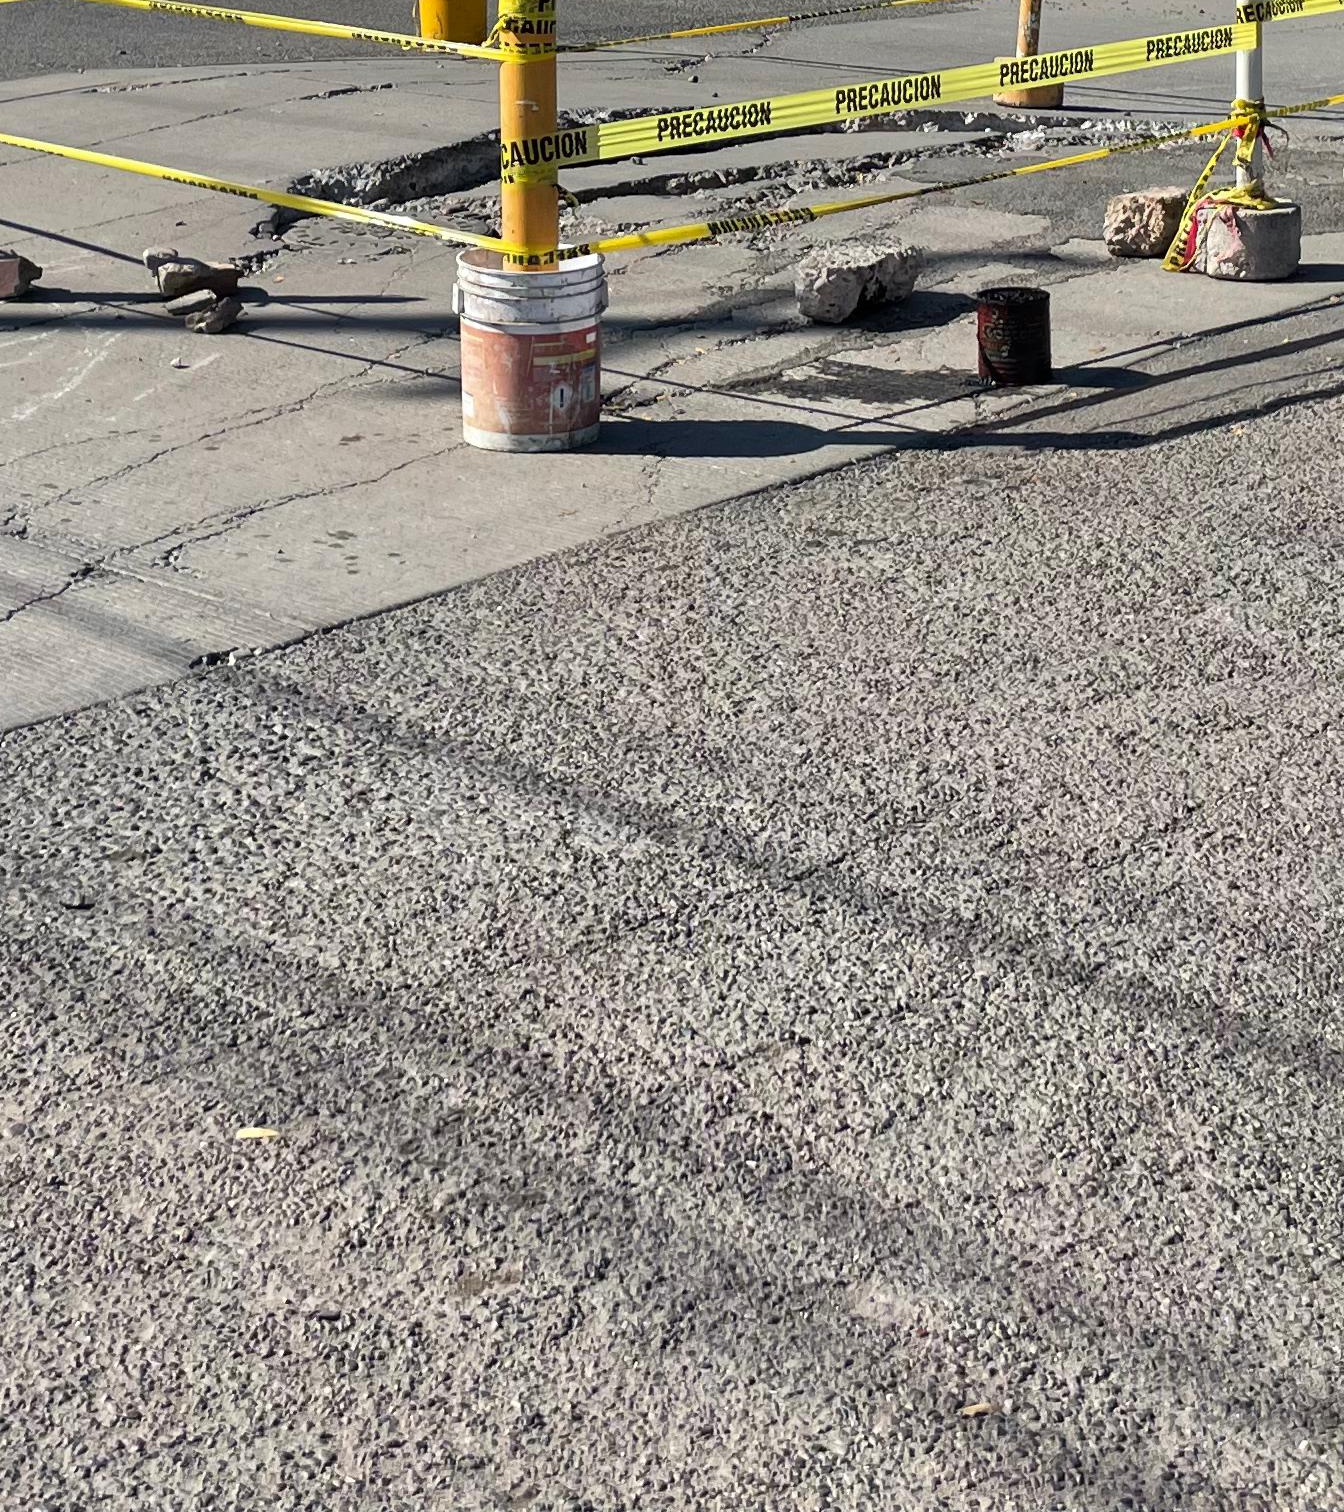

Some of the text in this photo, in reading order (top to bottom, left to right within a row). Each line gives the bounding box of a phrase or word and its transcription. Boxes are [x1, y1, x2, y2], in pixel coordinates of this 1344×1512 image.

[656, 101, 772, 143] PRECAUCION
[835, 74, 941, 115] PRECAUCION
[998, 49, 1095, 87] PRECAUCION
[1145, 26, 1234, 62] PRECAUCION
